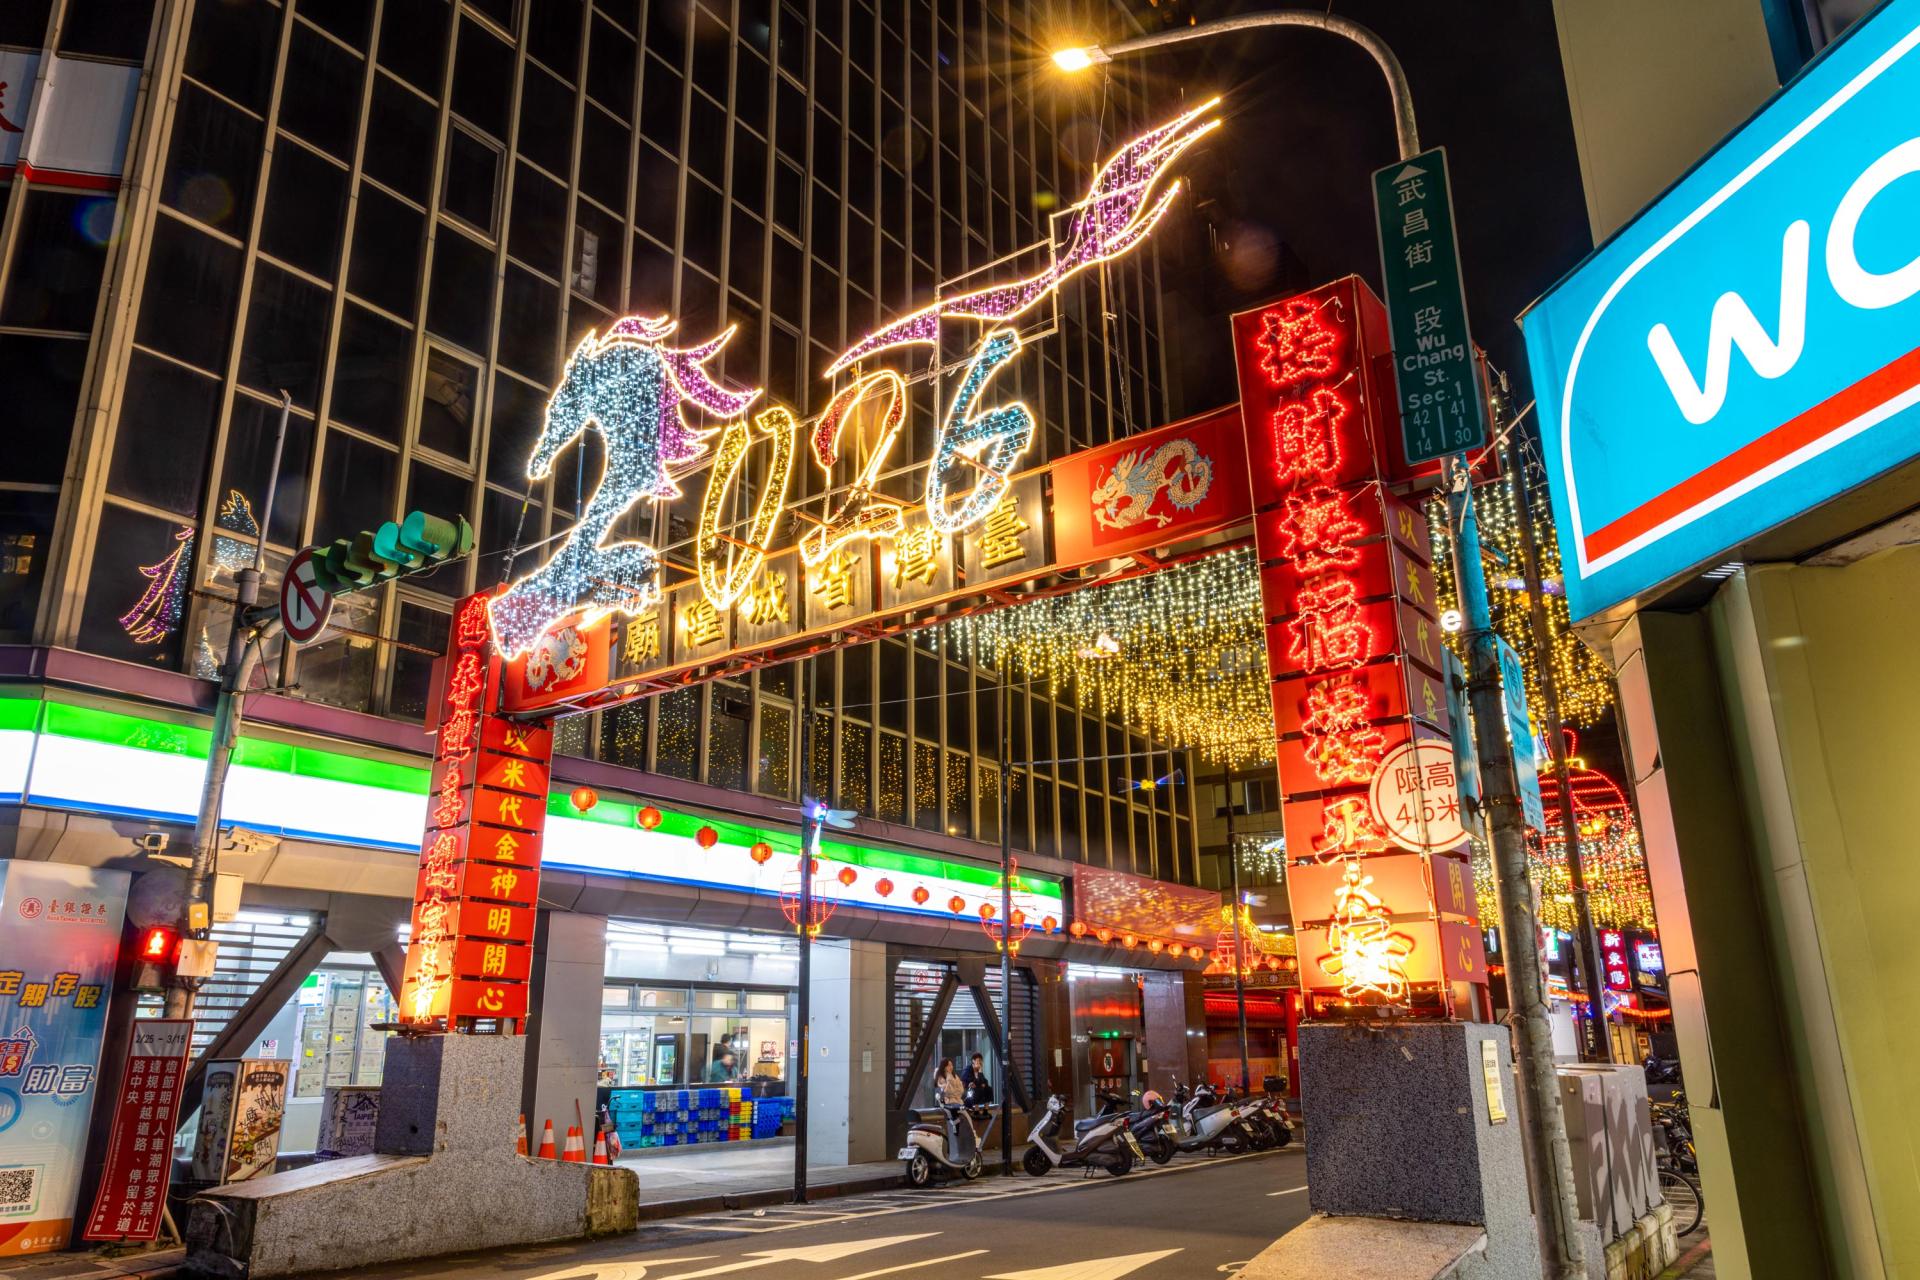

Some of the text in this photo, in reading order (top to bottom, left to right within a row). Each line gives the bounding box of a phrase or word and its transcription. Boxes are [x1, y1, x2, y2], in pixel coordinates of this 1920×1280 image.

[1397, 179, 1442, 335] 武昌街一段
[1417, 334, 1446, 351] Wu
[1403, 344, 1464, 372] Chang
[1424, 368, 1449, 387] St.
[1408, 381, 1462, 408] Sec. 1
[1450, 400, 1466, 416] 41
[1413, 410, 1431, 426] 42
[1416, 440, 1433, 455] 14
[1454, 429, 1472, 444] 30
[1399, 511, 1474, 974] 以米代金開心
[1396, 762, 1455, 795] 限高
[1396, 797, 1461, 826] 4.5米
[477, 729, 529, 1013] 以米代金神明開心
[0, 971, 102, 1008] 定期存股
[136, 1034, 155, 1044] 2/25
[167, 1034, 186, 1045] 3/15
[126, 1060, 146, 1104] 路中央
[134, 1060, 178, 1232] 燈節期間人車潮眾多禁止
